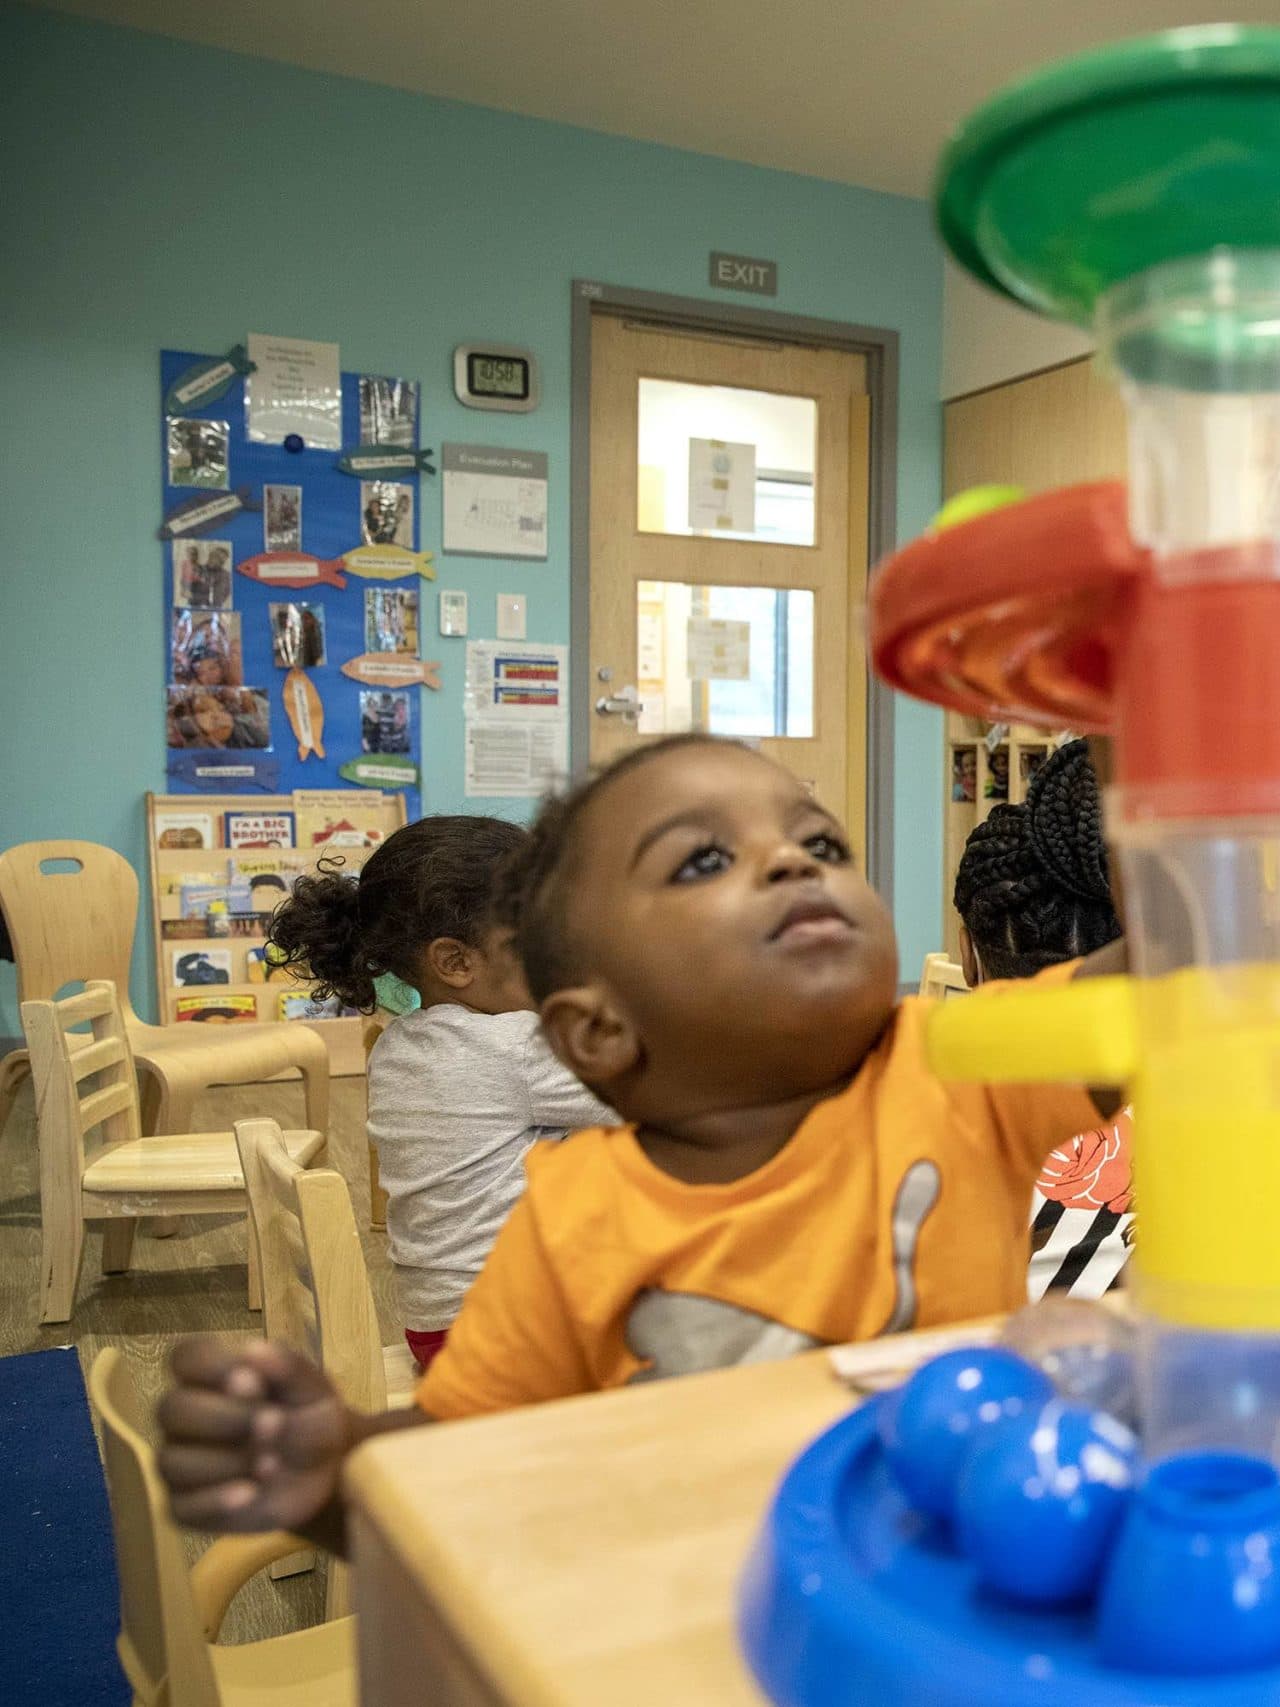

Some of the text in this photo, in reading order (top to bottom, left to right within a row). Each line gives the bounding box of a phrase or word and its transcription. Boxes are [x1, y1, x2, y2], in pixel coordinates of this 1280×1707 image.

[719, 260, 769, 287] EXIT
[459, 454, 534, 472] Evacuation Plan
[264, 820, 286, 828] BIG
[232, 831, 289, 840] BROTHER
